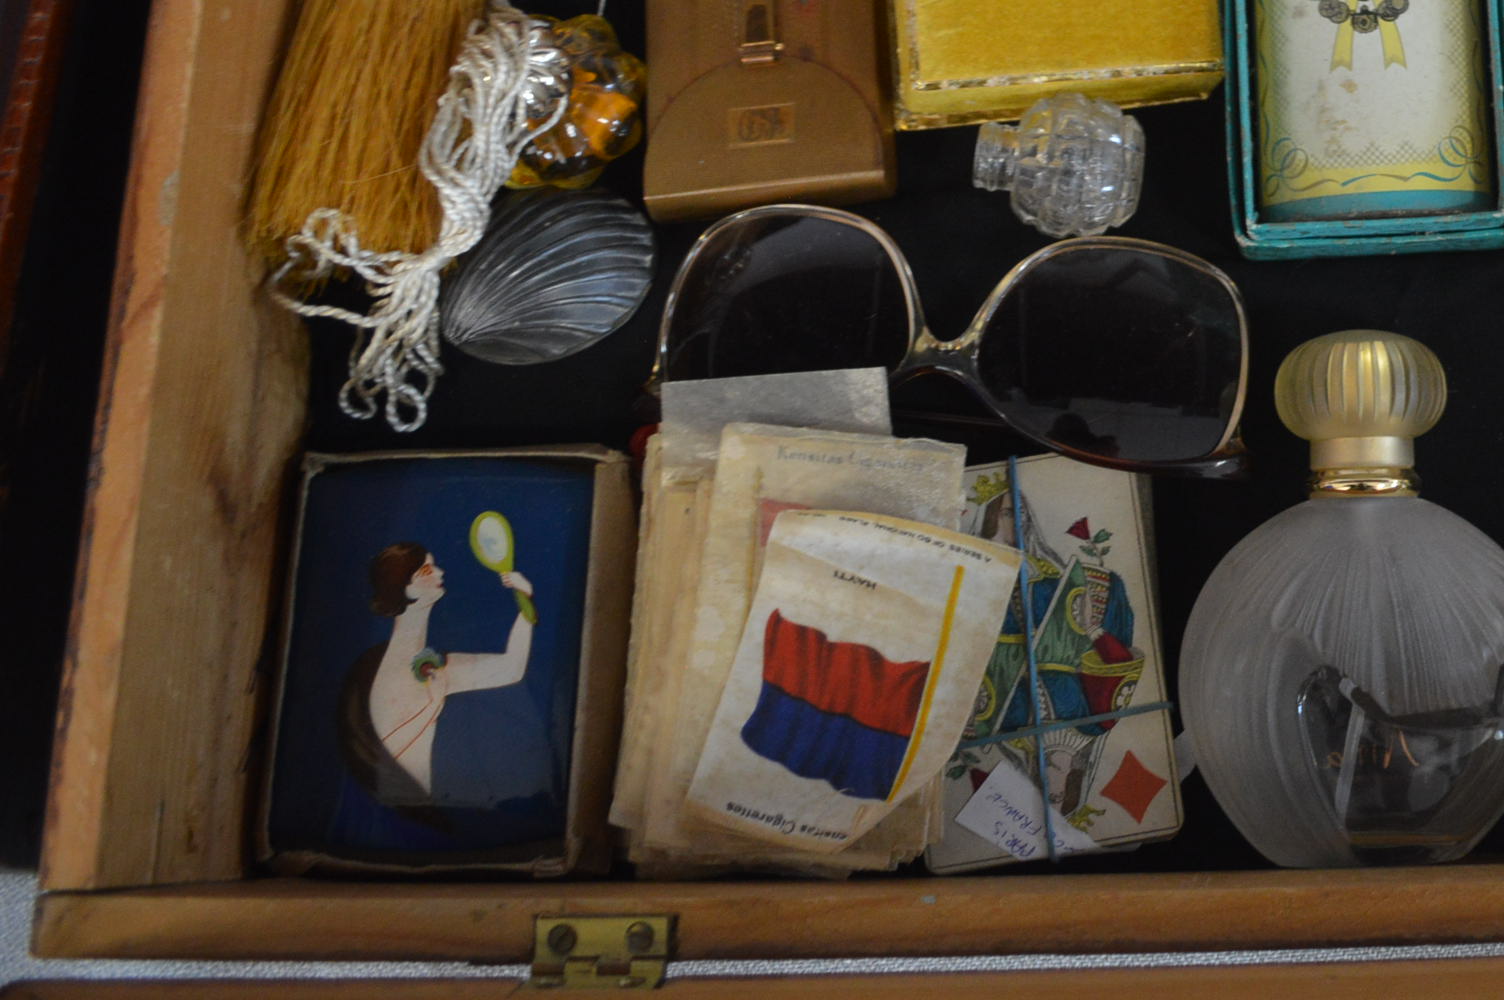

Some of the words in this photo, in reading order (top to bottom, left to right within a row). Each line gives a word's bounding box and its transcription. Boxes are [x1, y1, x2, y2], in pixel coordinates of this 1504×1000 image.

[873, 521, 916, 538] NATIONAL
[931, 539, 945, 549] OF
[949, 544, 982, 561] SERIES
[983, 555, 992, 564] A
[833, 569, 877, 590] HAYTI
[725, 801, 796, 836] Cigarettes
[800, 824, 848, 841] ensitas
[992, 821, 1037, 858] PARIS
